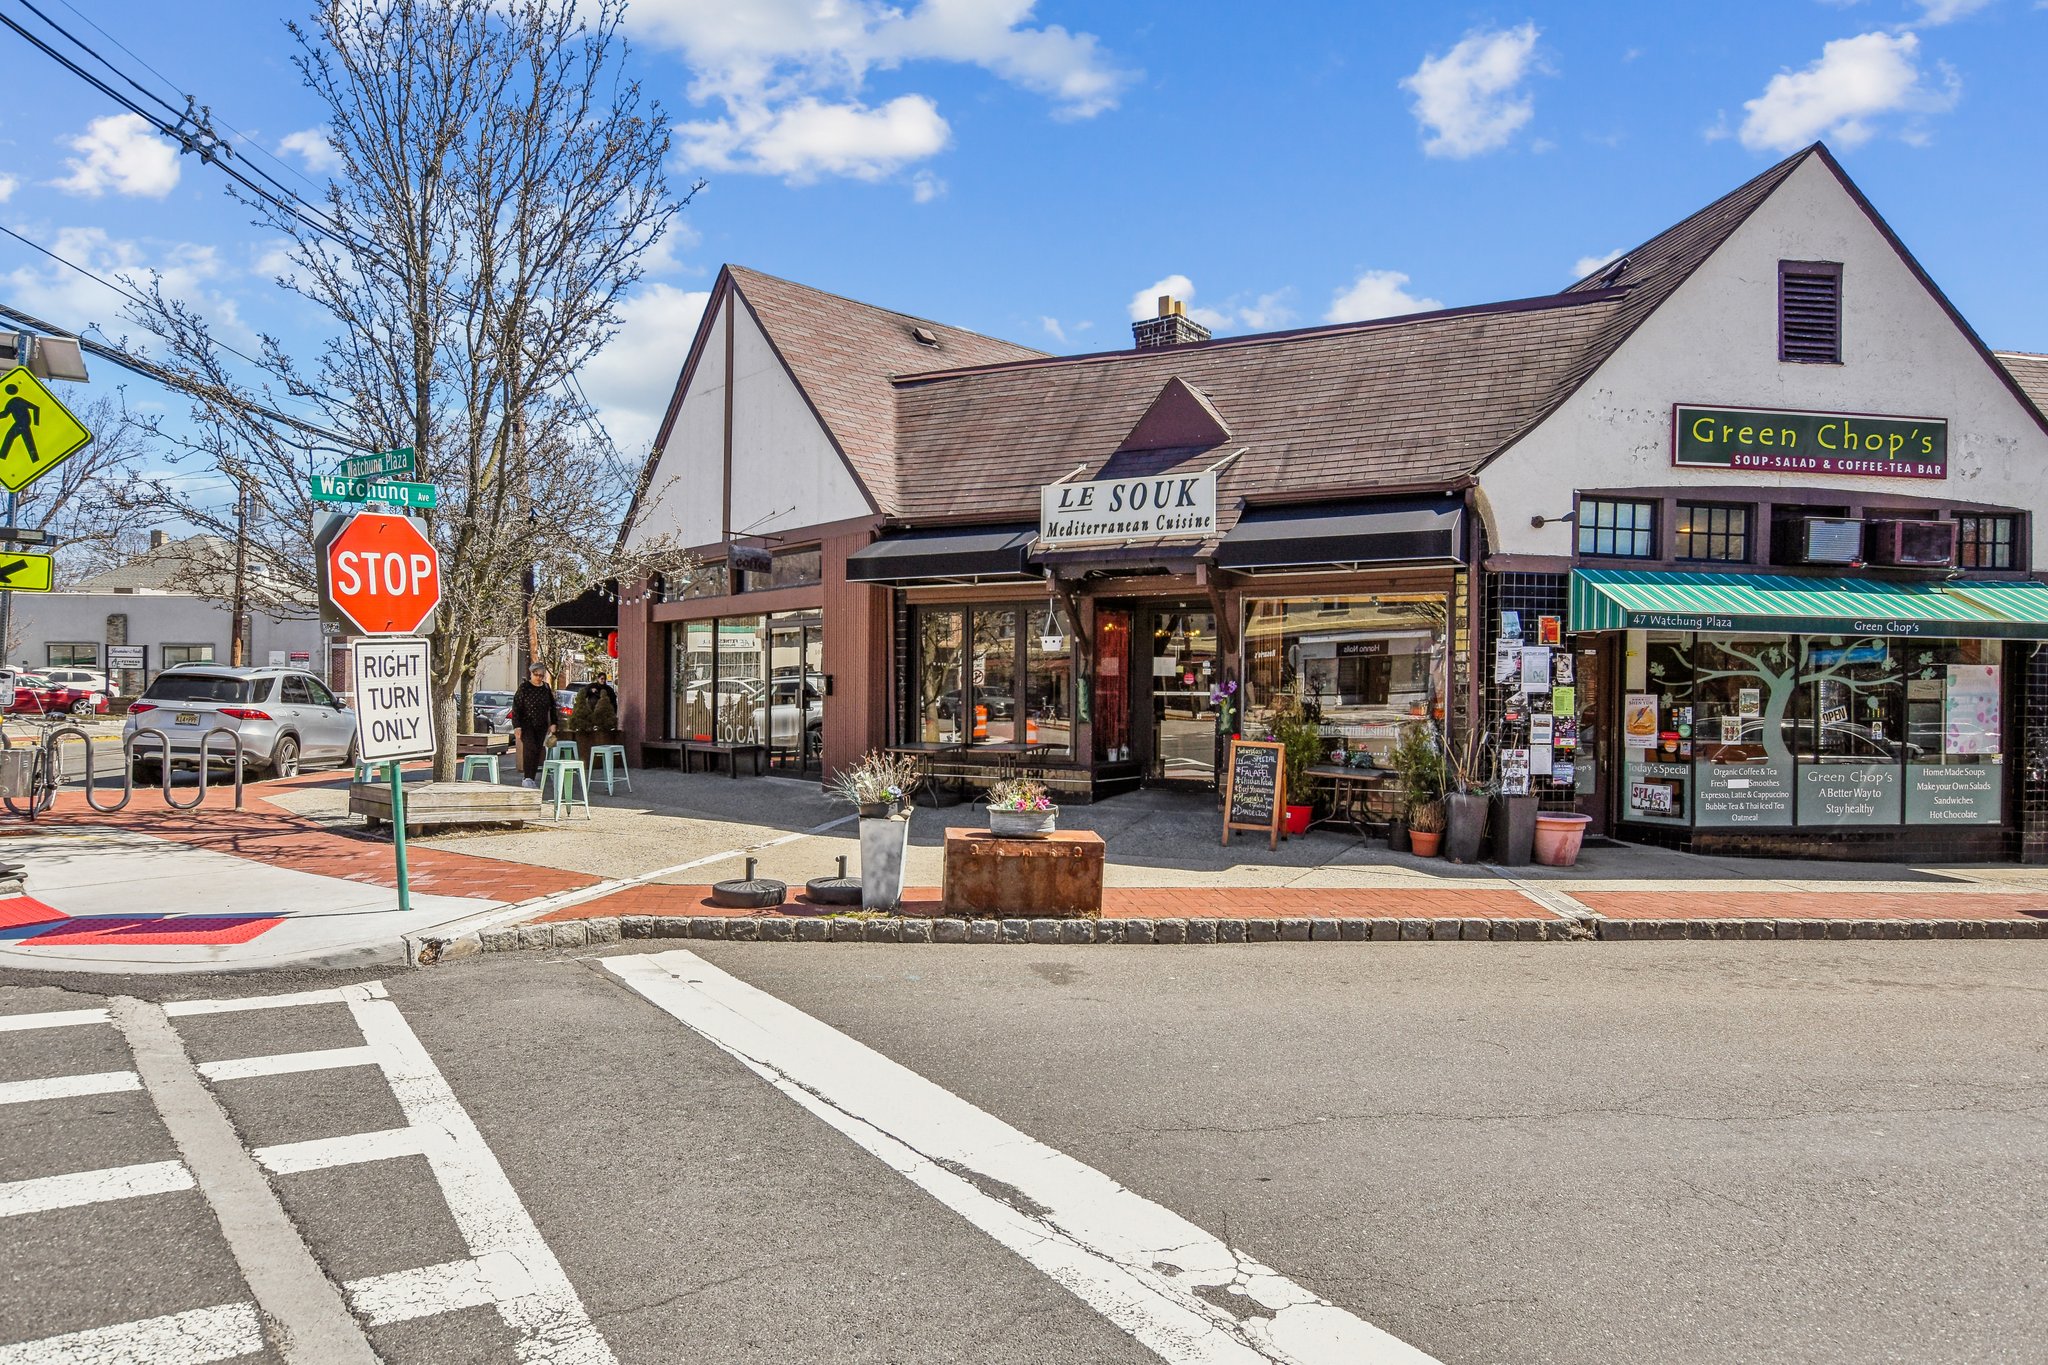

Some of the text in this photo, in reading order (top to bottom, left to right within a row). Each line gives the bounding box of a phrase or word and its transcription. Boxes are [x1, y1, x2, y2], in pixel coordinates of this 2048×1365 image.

[1692, 417, 1933, 460] Green Chop's
[347, 453, 408, 477] Watchung Plaza
[1734, 454, 1942, 475] SOUP-SALAD & COFFEE-TEA BAR
[320, 476, 430, 506] Watchung Ave
[1058, 478, 1200, 512] LE SOUK
[1046, 513, 1211, 538] Mediterranean Cuisine
[735, 556, 771, 571] coffee
[337, 550, 432, 596] STOP
[1633, 614, 1732, 630] 47 Watchung Plaza
[1854, 620, 1920, 635] Green Chop's
[364, 655, 420, 678] RIGHT
[368, 685, 420, 710] TURN
[1821, 706, 1847, 725] OPEN
[372, 717, 420, 743] ONLY
[716, 723, 766, 745] LOCAL
[1628, 763, 1689, 777] Today's Special
[1713, 767, 1778, 778] Organic Coffee & Tea
[1807, 769, 1893, 786] Green Chop's
[1922, 767, 1986, 778] Home Made Soups
[1710, 779, 1728, 787] Fresh
[1916, 781, 1991, 793] Make your Own Salads
[1731, 791, 1746, 799] Latte
[1753, 790, 1790, 801] Cappuccino
[1818, 788, 1882, 801] A Better Way to
[1933, 796, 1974, 805] Sandwiches
[1705, 802, 1785, 810] Bubble Tea & Thai Iced Tea
[1825, 803, 1875, 817] Stay healthy
[1731, 813, 1759, 821] Oatmeal
[1929, 810, 1978, 819] Hot Chocolate
